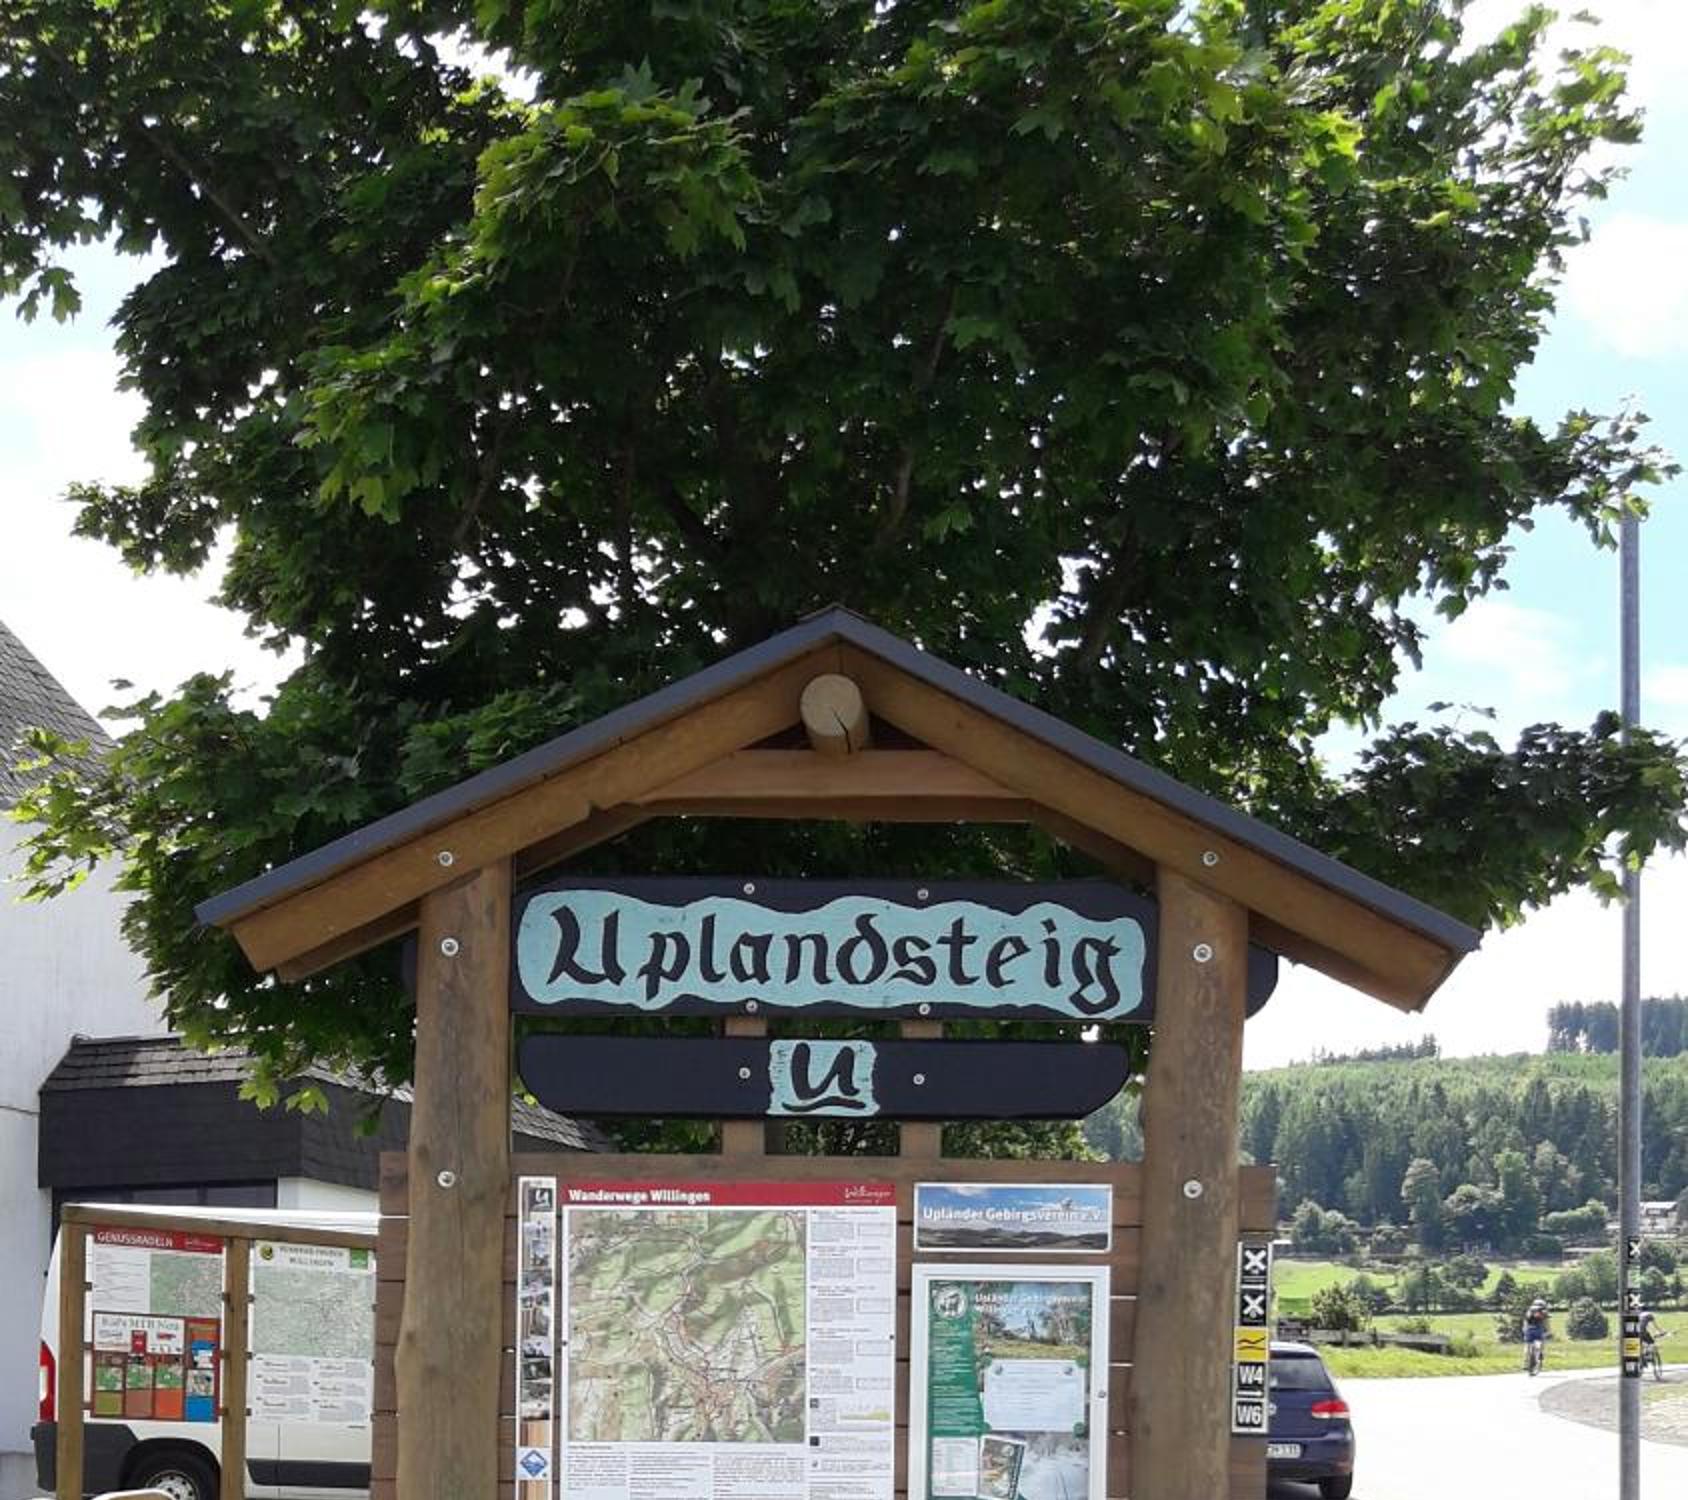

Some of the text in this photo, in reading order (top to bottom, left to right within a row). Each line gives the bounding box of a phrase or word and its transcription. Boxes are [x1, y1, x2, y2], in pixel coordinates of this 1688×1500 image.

[546, 905, 1121, 1015] Uplandsteig
[569, 1189, 711, 1204] Wanderwege Willingen
[923, 1206, 982, 1221] Upländer
[985, 1206, 1077, 1222] Gebirgsverein
[97, 1231, 173, 1248] GENUSSRADELN
[1239, 1365, 1264, 1385] W4
[1236, 1405, 1262, 1425] W6
